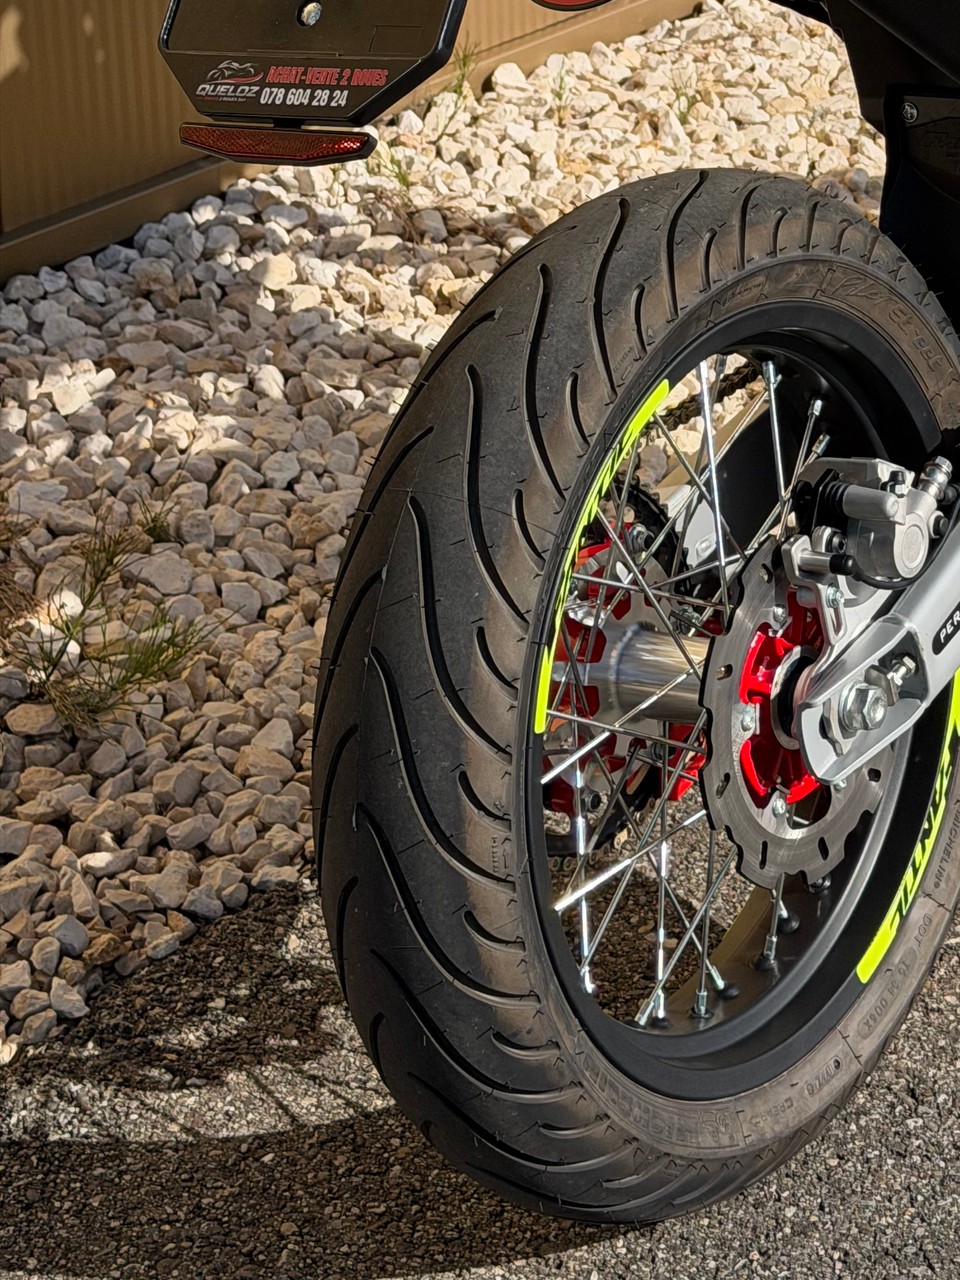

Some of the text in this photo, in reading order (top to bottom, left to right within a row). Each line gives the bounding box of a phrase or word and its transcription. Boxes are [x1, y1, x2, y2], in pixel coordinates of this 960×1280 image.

[265, 65, 389, 87] ACHAT-VENTE 2 ROUES
[196, 84, 261, 97] QUELOZ
[260, 88, 349, 107] 078 604 28 24
